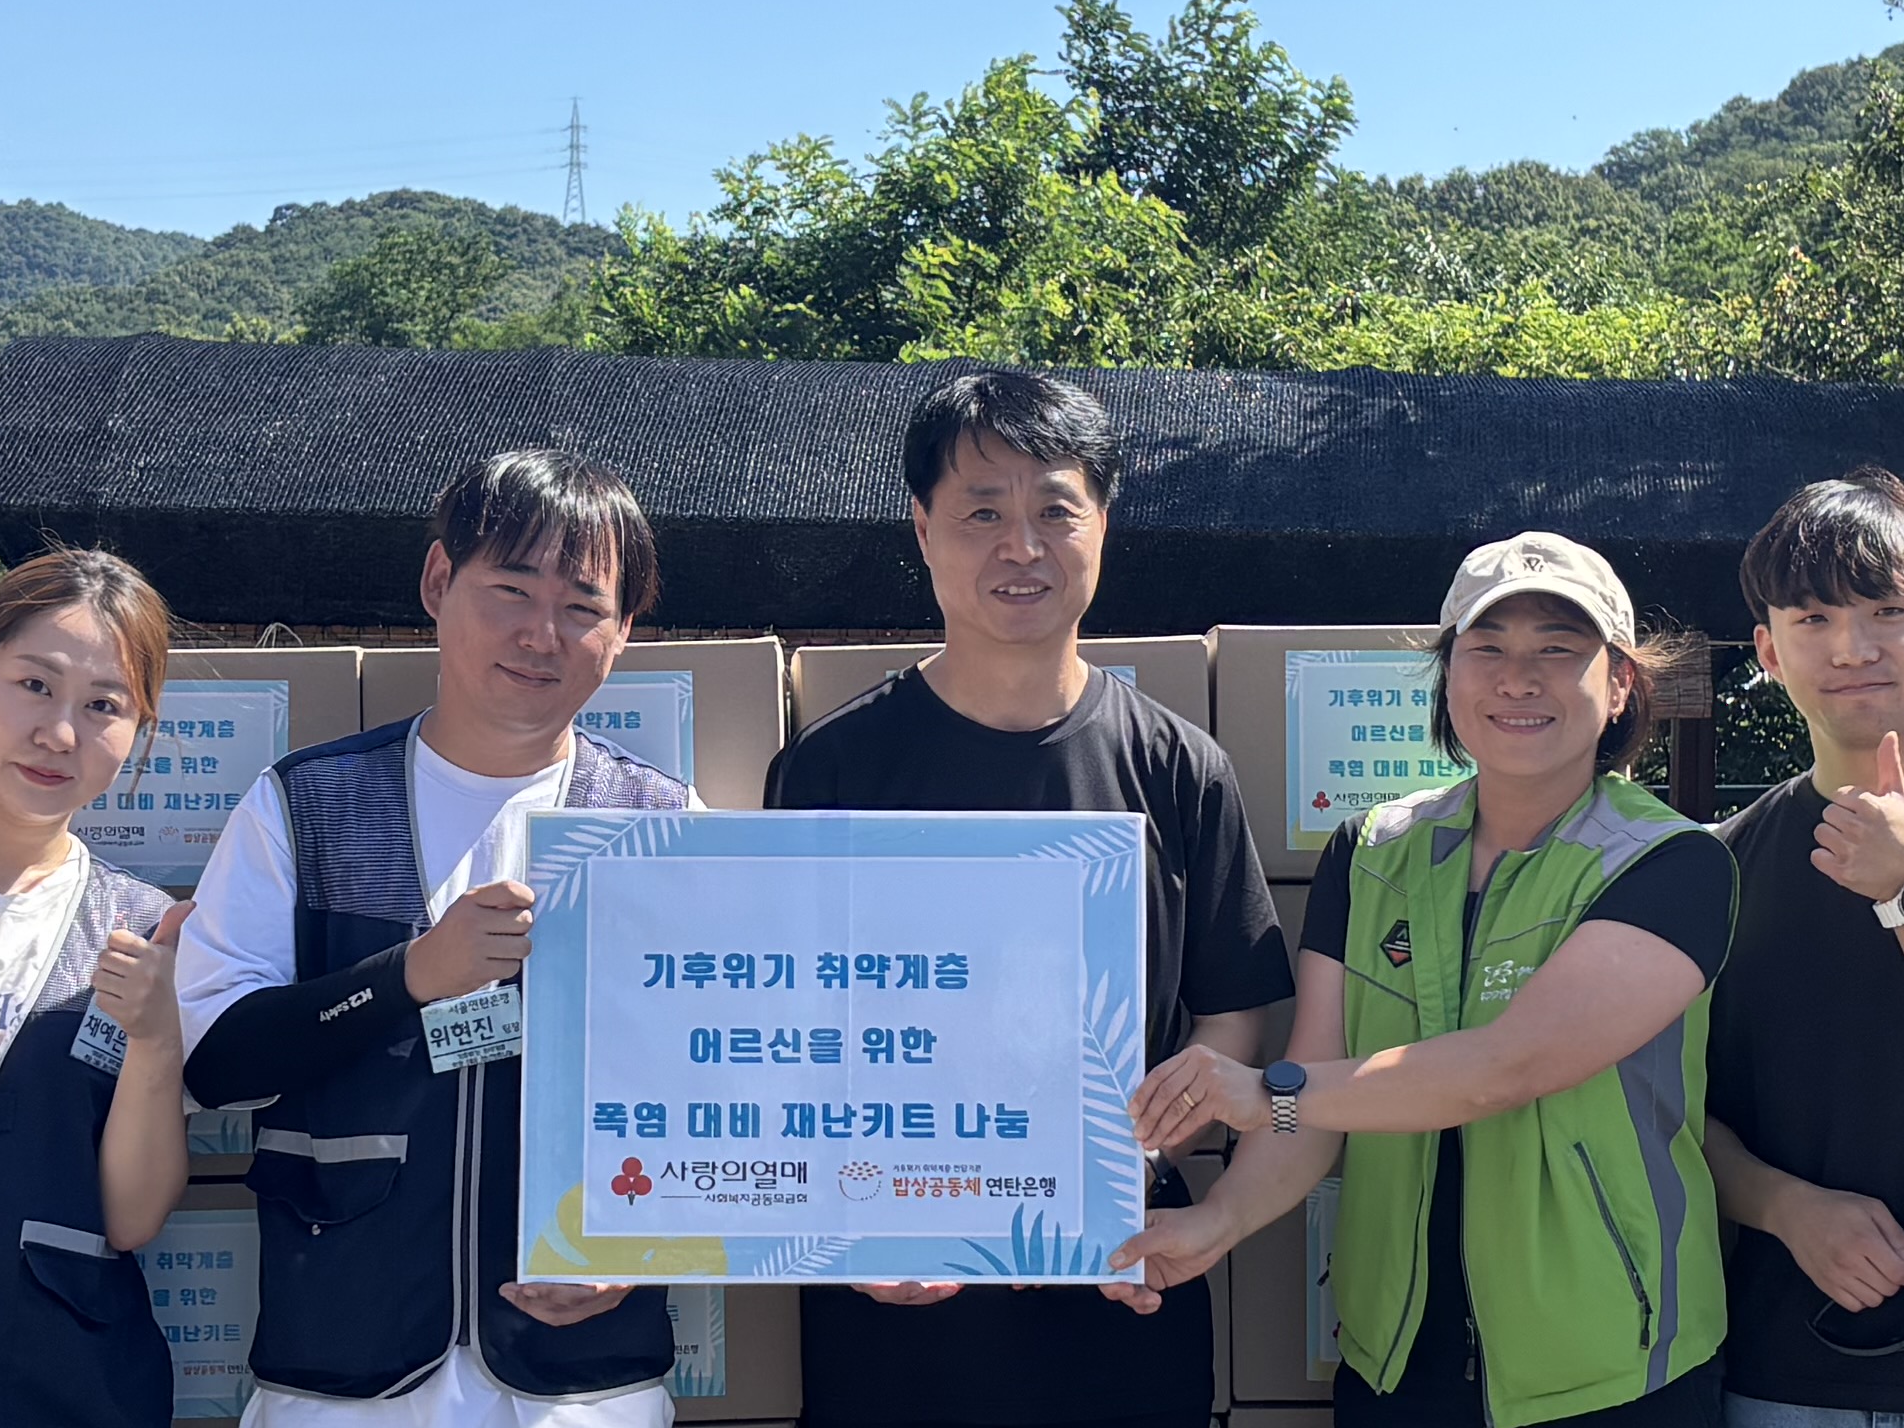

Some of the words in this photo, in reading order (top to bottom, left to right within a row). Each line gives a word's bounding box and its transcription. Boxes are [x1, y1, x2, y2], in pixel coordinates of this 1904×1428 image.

[1329, 688, 1401, 707] 기후위기
[159, 720, 235, 738] 취약계층
[1351, 724, 1424, 742] 어르신을
[181, 756, 219, 774] 위한
[1328, 759, 1364, 778] 폭염
[1373, 759, 1409, 777] 대비
[117, 793, 154, 810] 대비
[164, 792, 242, 811] 재난키트
[642, 952, 795, 990] 기후위기
[814, 952, 970, 990] 취약계층
[429, 1015, 495, 1049] 위현진
[688, 1026, 843, 1065] 어르신을
[861, 1026, 938, 1065] 위한
[592, 1101, 667, 1139] 폭염
[687, 1101, 760, 1139] 대비
[780, 1101, 936, 1139] 재난키트
[954, 1101, 1030, 1140] 나눔
[660, 1160, 808, 1191] 사랑의열매
[892, 1176, 982, 1198] 밥상공동체
[985, 1176, 1057, 1199] 연탄은행
[704, 1193, 808, 1207] 사회복지공동모금회
[157, 1250, 234, 1270] 취약계층
[179, 1287, 217, 1306] 위한
